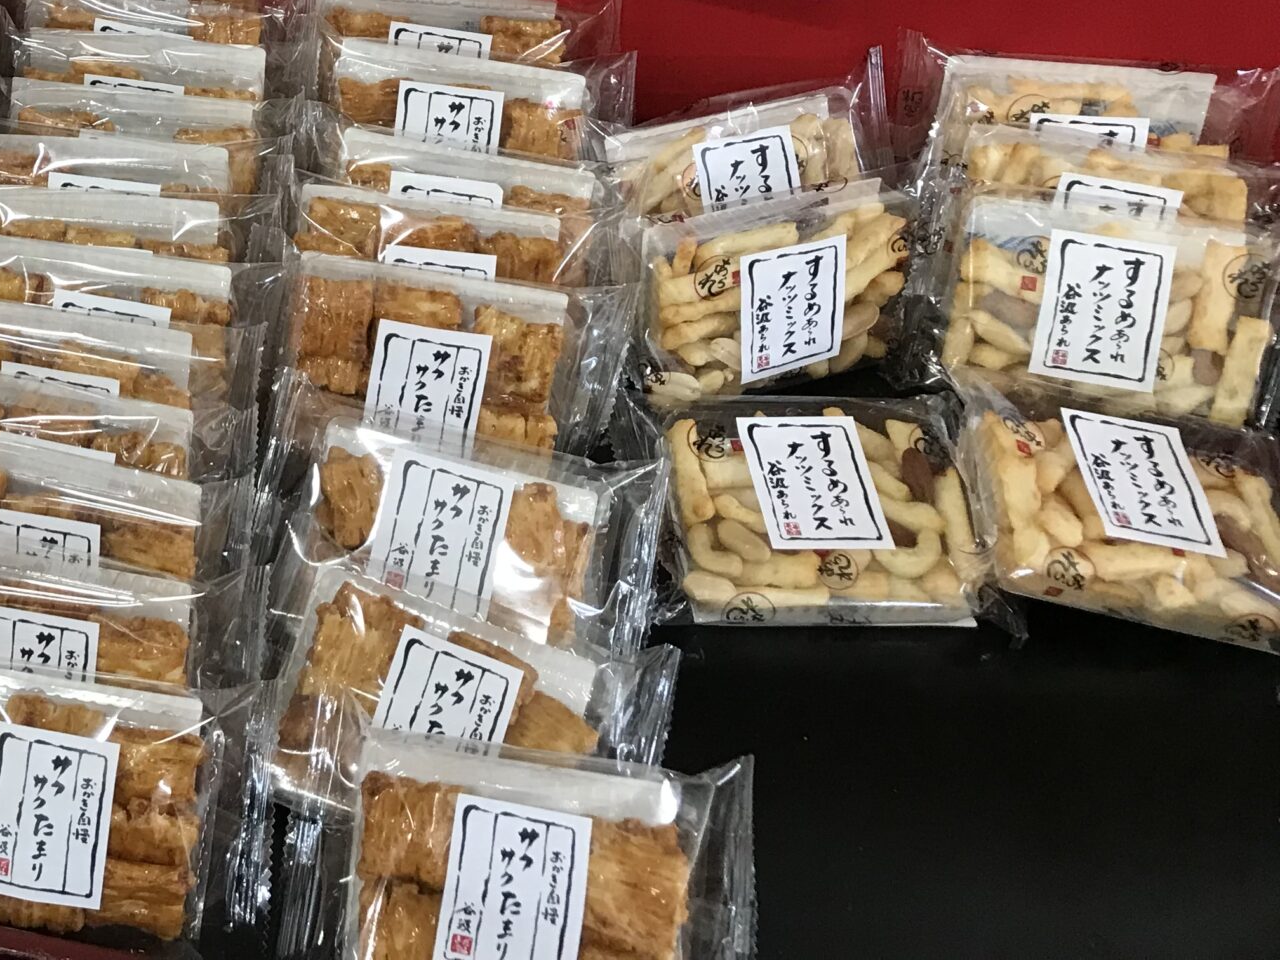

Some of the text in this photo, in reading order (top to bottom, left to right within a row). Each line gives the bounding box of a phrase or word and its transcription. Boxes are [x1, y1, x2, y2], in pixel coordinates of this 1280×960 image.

[751, 144, 773, 200] する
[778, 270, 798, 357] ナッツミックス
[801, 255, 824, 344] するめあられ
[1082, 264, 1115, 364] ナッツミックス
[1110, 257, 1146, 364] するめあられ
[787, 442, 834, 531] ナッツミックス
[810, 431, 856, 526] するめあられ
[1111, 439, 1163, 527] ナッツミックス
[1133, 435, 1184, 527] するめあられ
